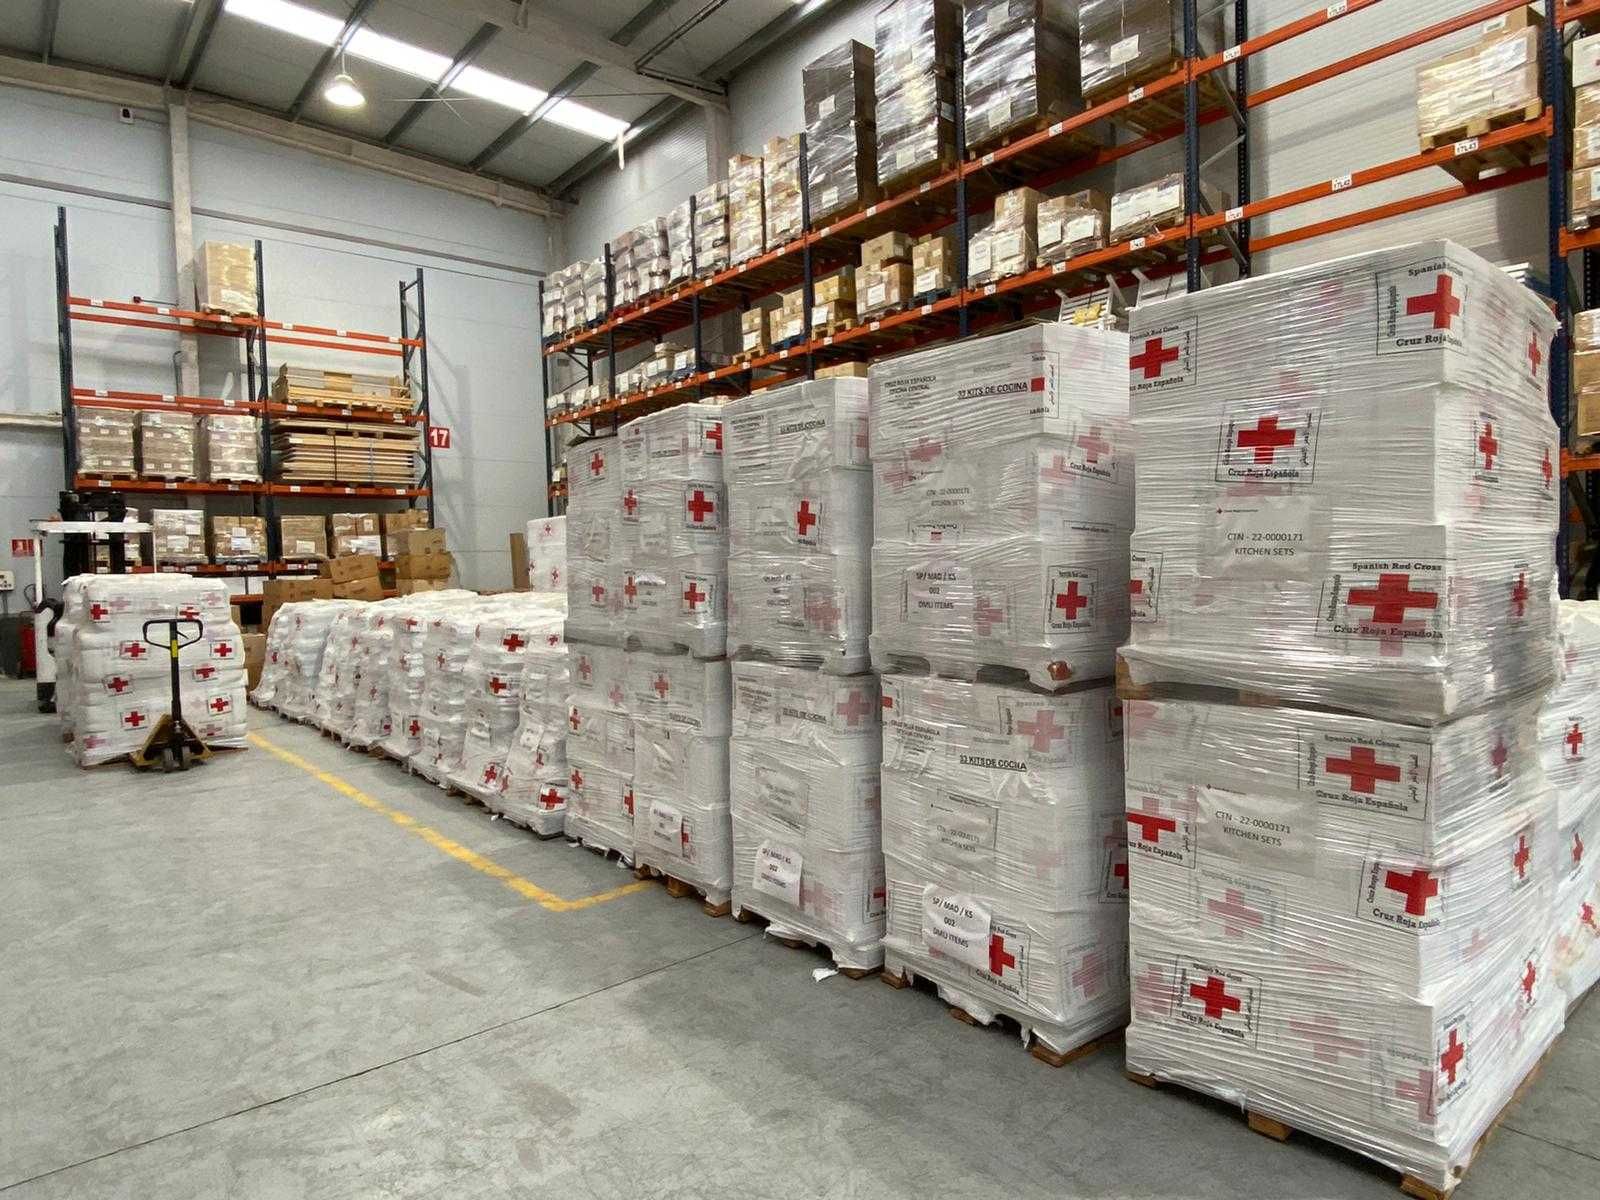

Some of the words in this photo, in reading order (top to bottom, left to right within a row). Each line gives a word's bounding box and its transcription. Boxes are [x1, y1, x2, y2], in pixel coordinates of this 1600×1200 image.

[1408, 262, 1446, 276] Spanish
[1396, 337, 1422, 347] Cruz
[1154, 376, 1184, 387] Española
[985, 386, 996, 394] DE
[997, 382, 1028, 392] COCINA
[430, 428, 448, 446] 17
[1227, 533, 1244, 541] CTN
[1234, 548, 1271, 556] KITCHEN
[1273, 548, 1295, 556] SETS
[1352, 563, 1388, 571] Spanish
[1392, 562, 1410, 570] Red
[1414, 563, 1442, 571] Cross
[1333, 625, 1359, 634] Cruz
[1361, 626, 1386, 636] Roja
[986, 758, 996, 767] DE
[998, 760, 1027, 770] COCINA
[1316, 790, 1340, 800] Cruz
[1342, 794, 1364, 804] Roja
[1366, 796, 1408, 812] Española
[1215, 810, 1232, 820] CTN
[1224, 826, 1260, 840] KITCHEN
[1261, 835, 1282, 846] SETS
[1153, 846, 1183, 860] Española
[965, 910, 974, 918] KS
[1372, 908, 1394, 921] Cruz
[1396, 915, 1417, 928] Roja
[944, 916, 956, 927] 002
